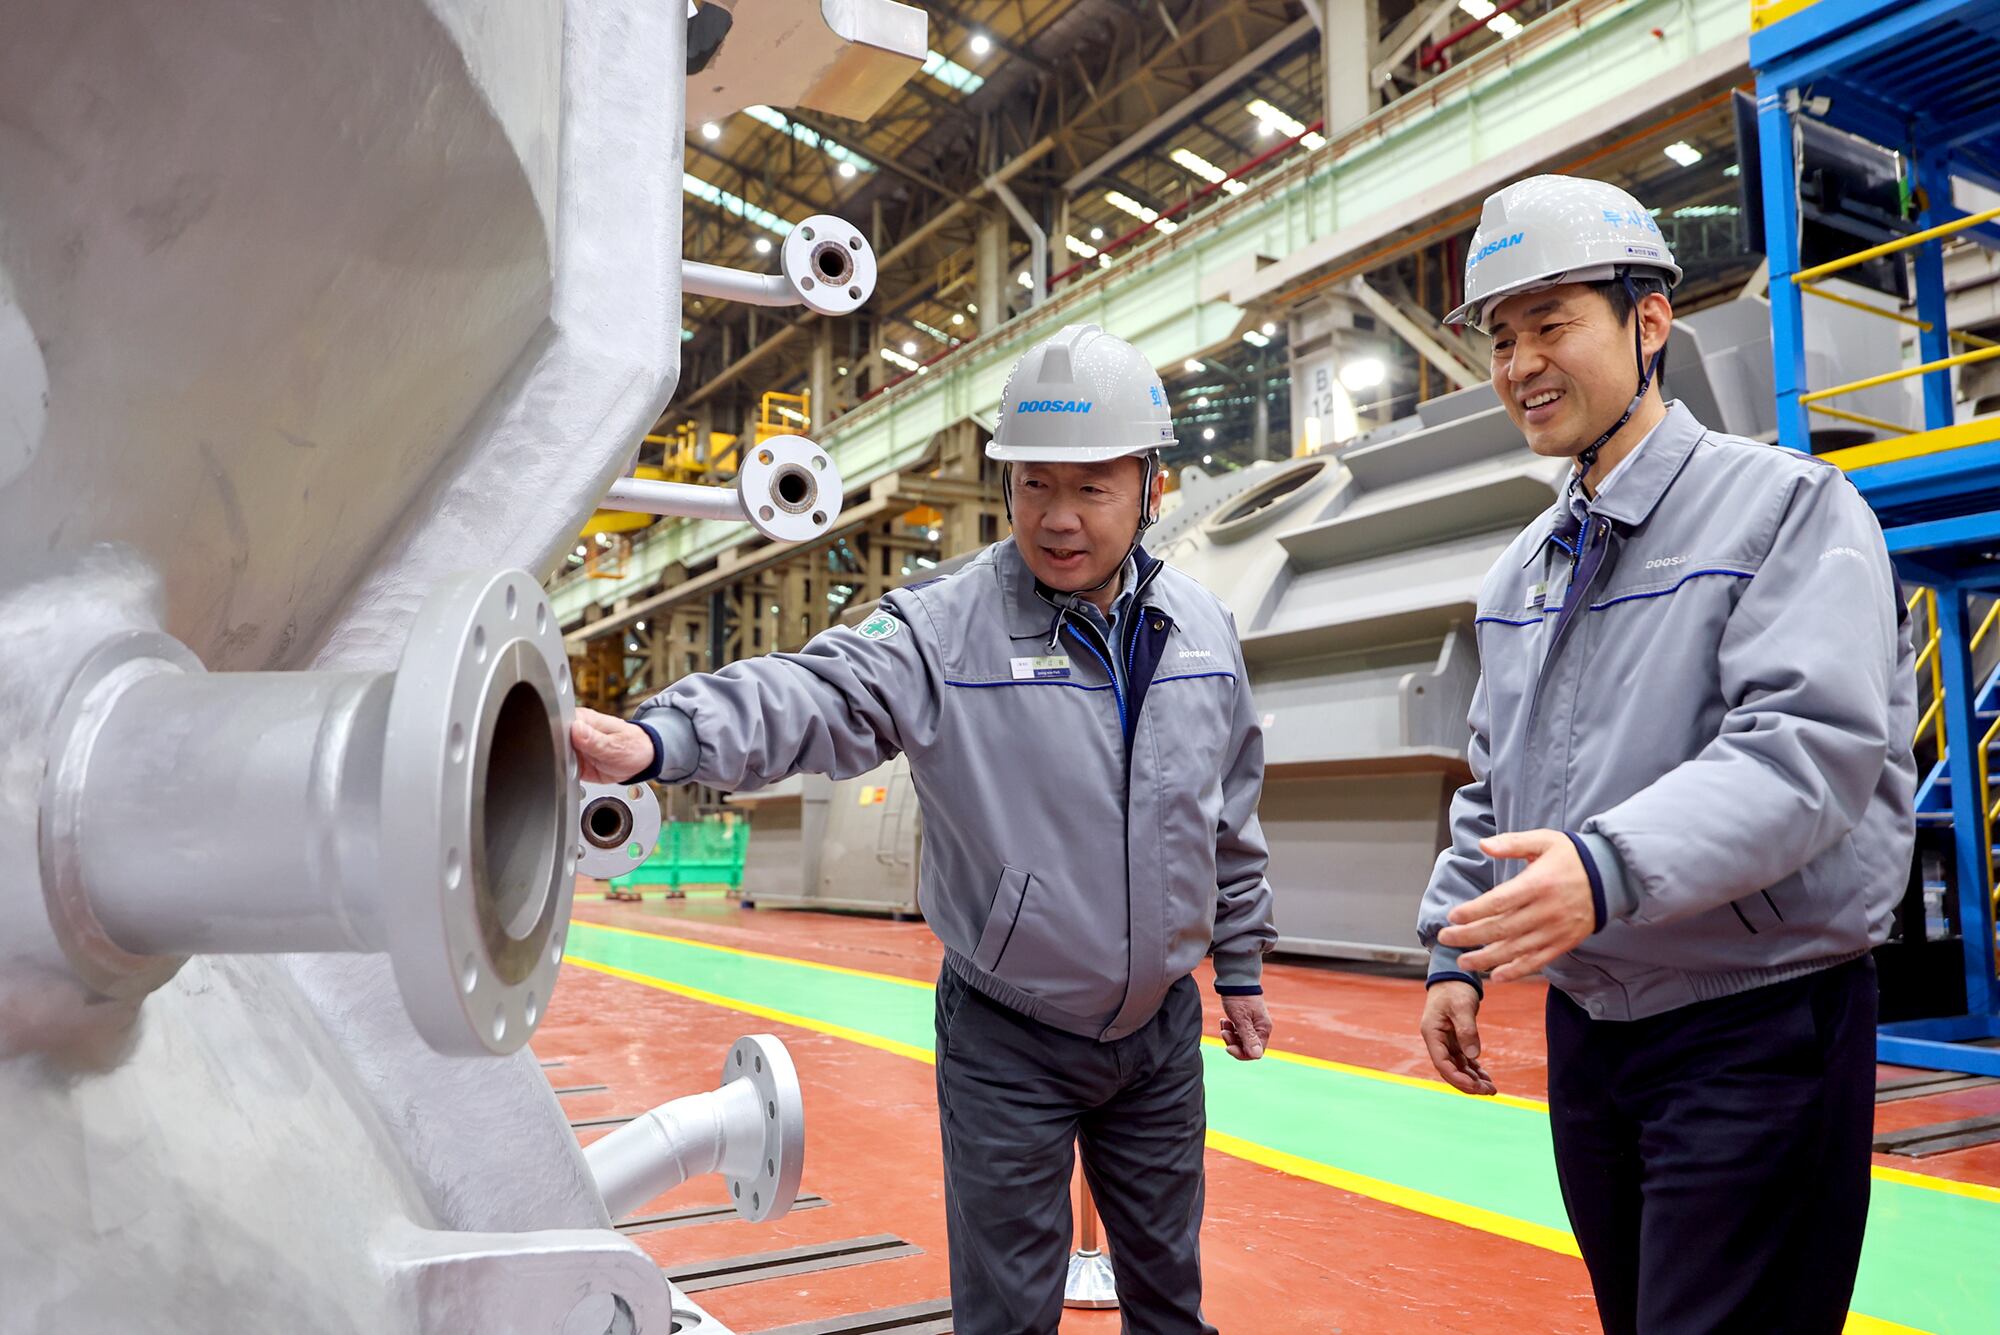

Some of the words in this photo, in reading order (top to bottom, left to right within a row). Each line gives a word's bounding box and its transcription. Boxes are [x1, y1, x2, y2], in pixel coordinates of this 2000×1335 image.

[1316, 369, 1328, 391] B
[1017, 400, 1092, 414] DOOSAN
[1645, 554, 1692, 569] DOOSA
[1179, 650, 1211, 658] DOOSAN
